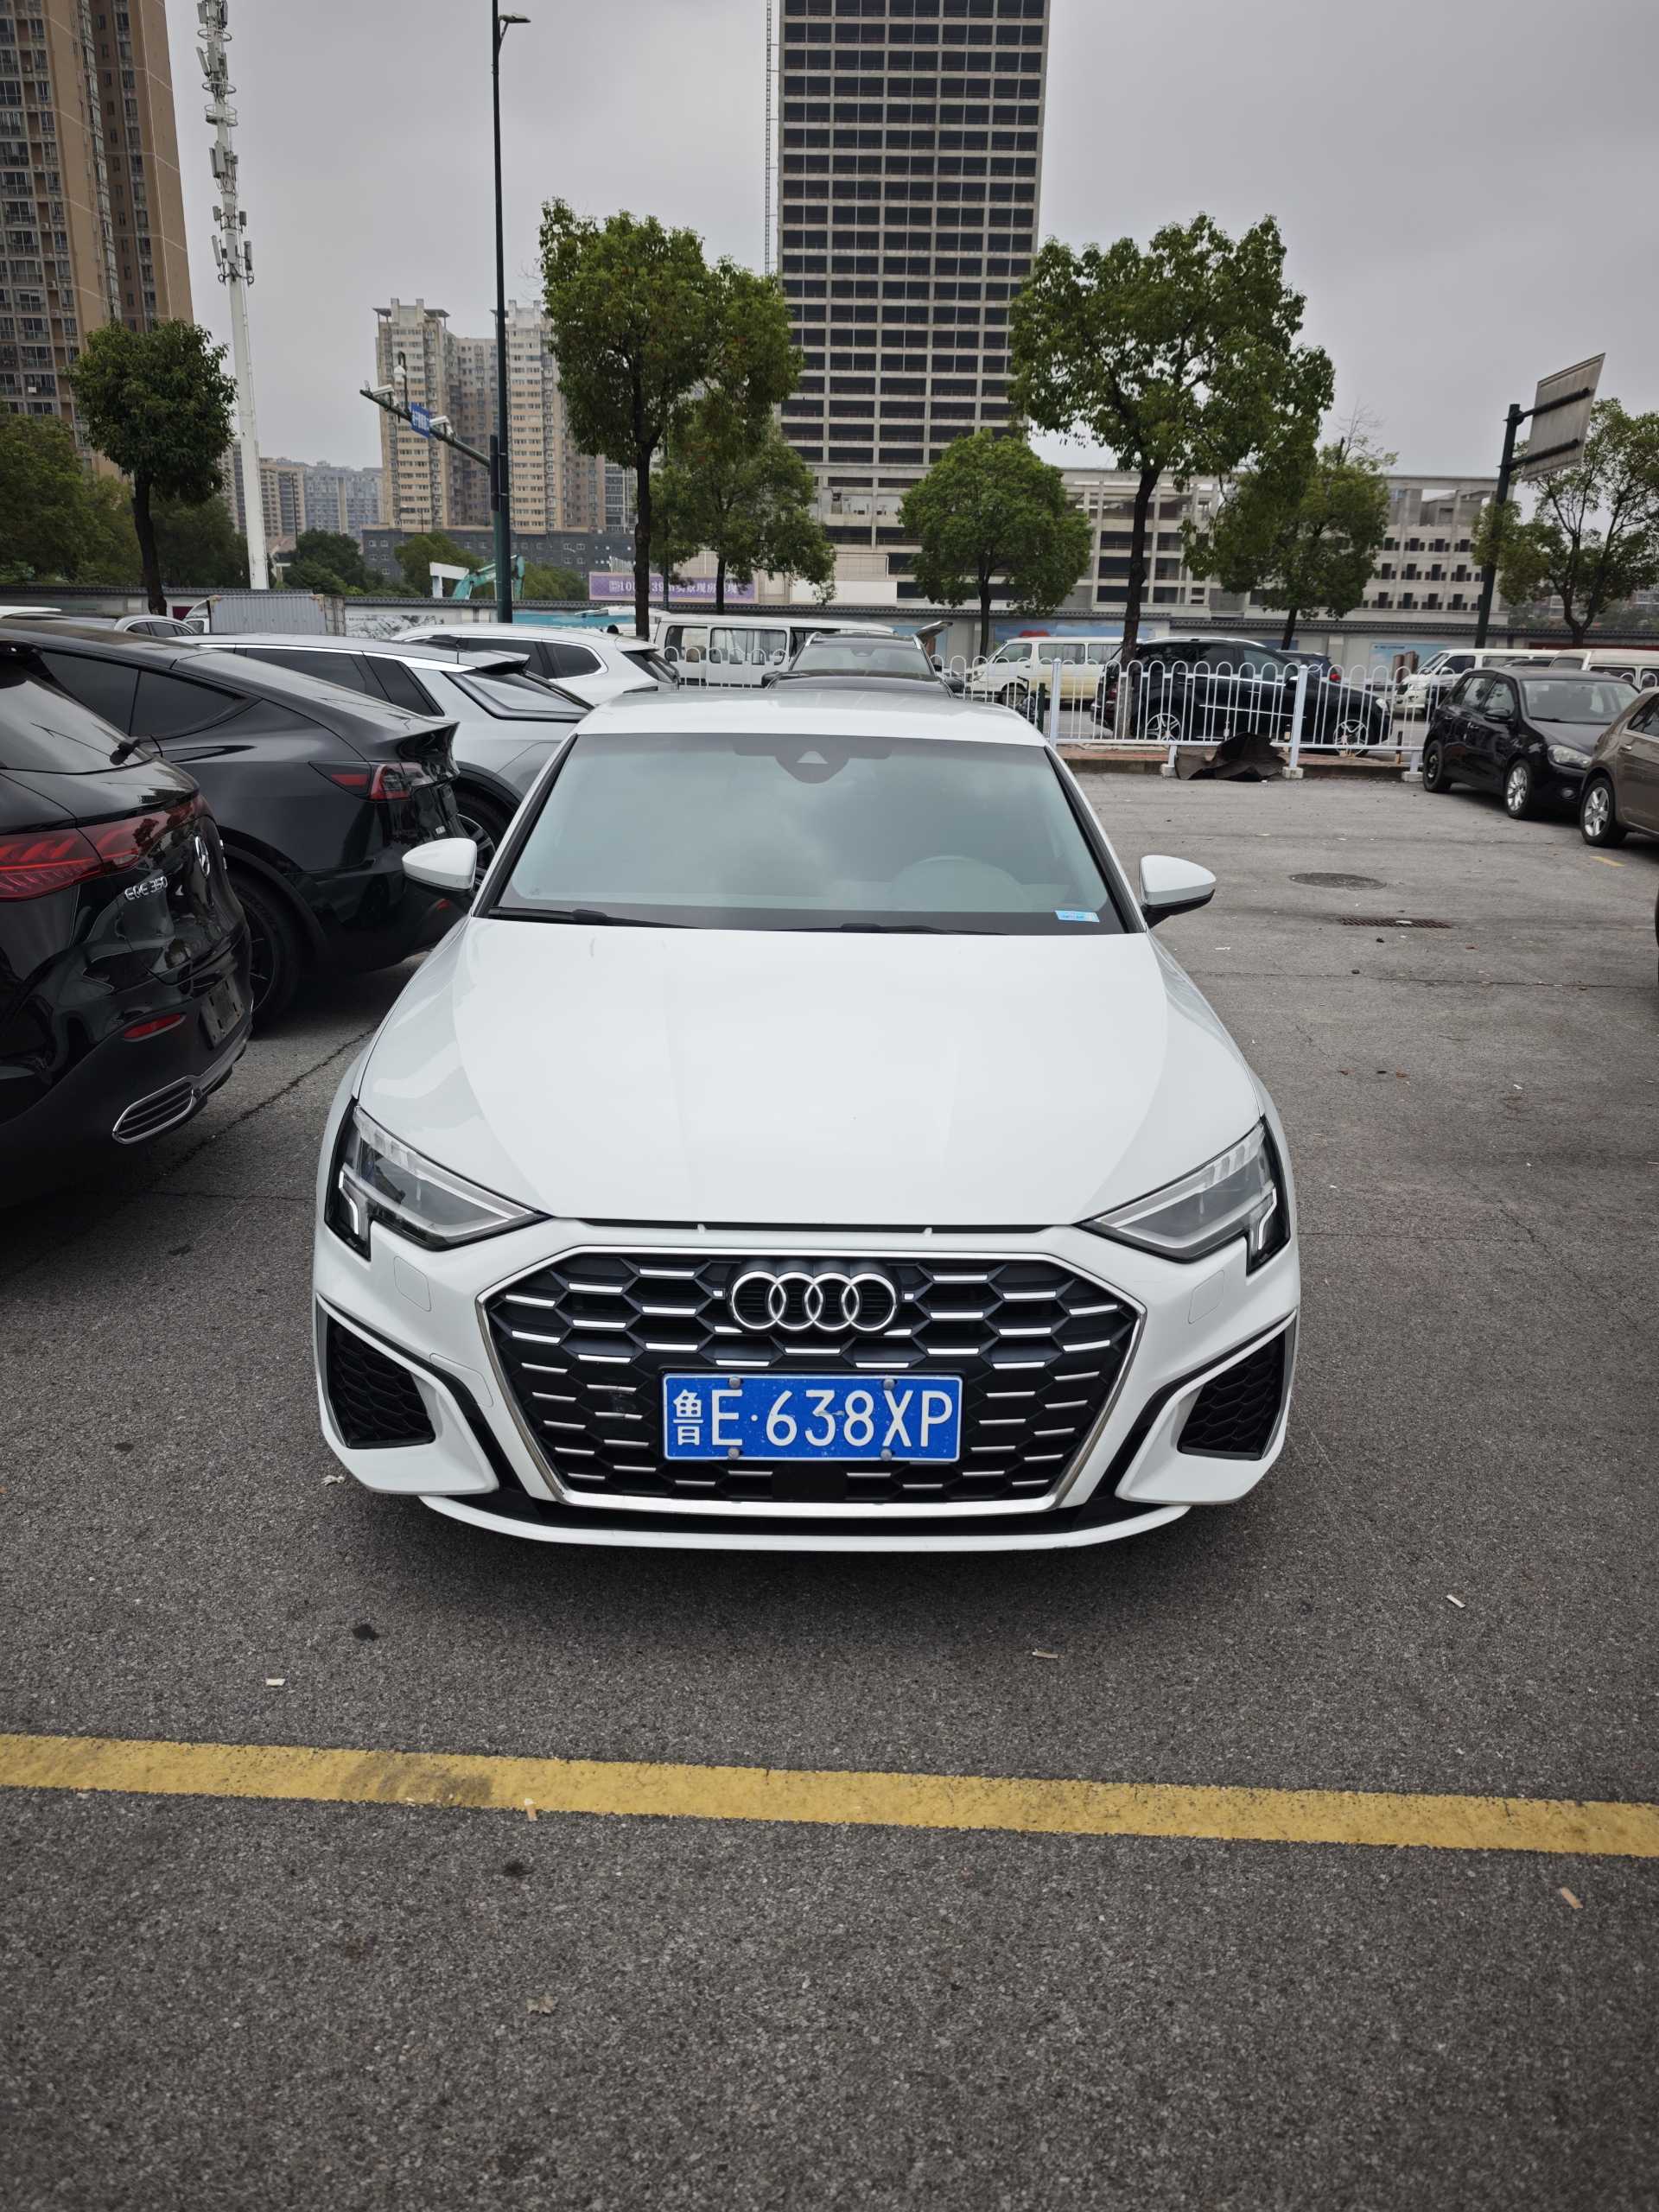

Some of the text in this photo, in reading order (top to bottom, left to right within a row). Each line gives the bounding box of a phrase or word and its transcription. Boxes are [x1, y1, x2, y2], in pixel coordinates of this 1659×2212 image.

[124, 876, 168, 900] EQE 350
[673, 1389, 953, 1447] 鲁E·638XP
